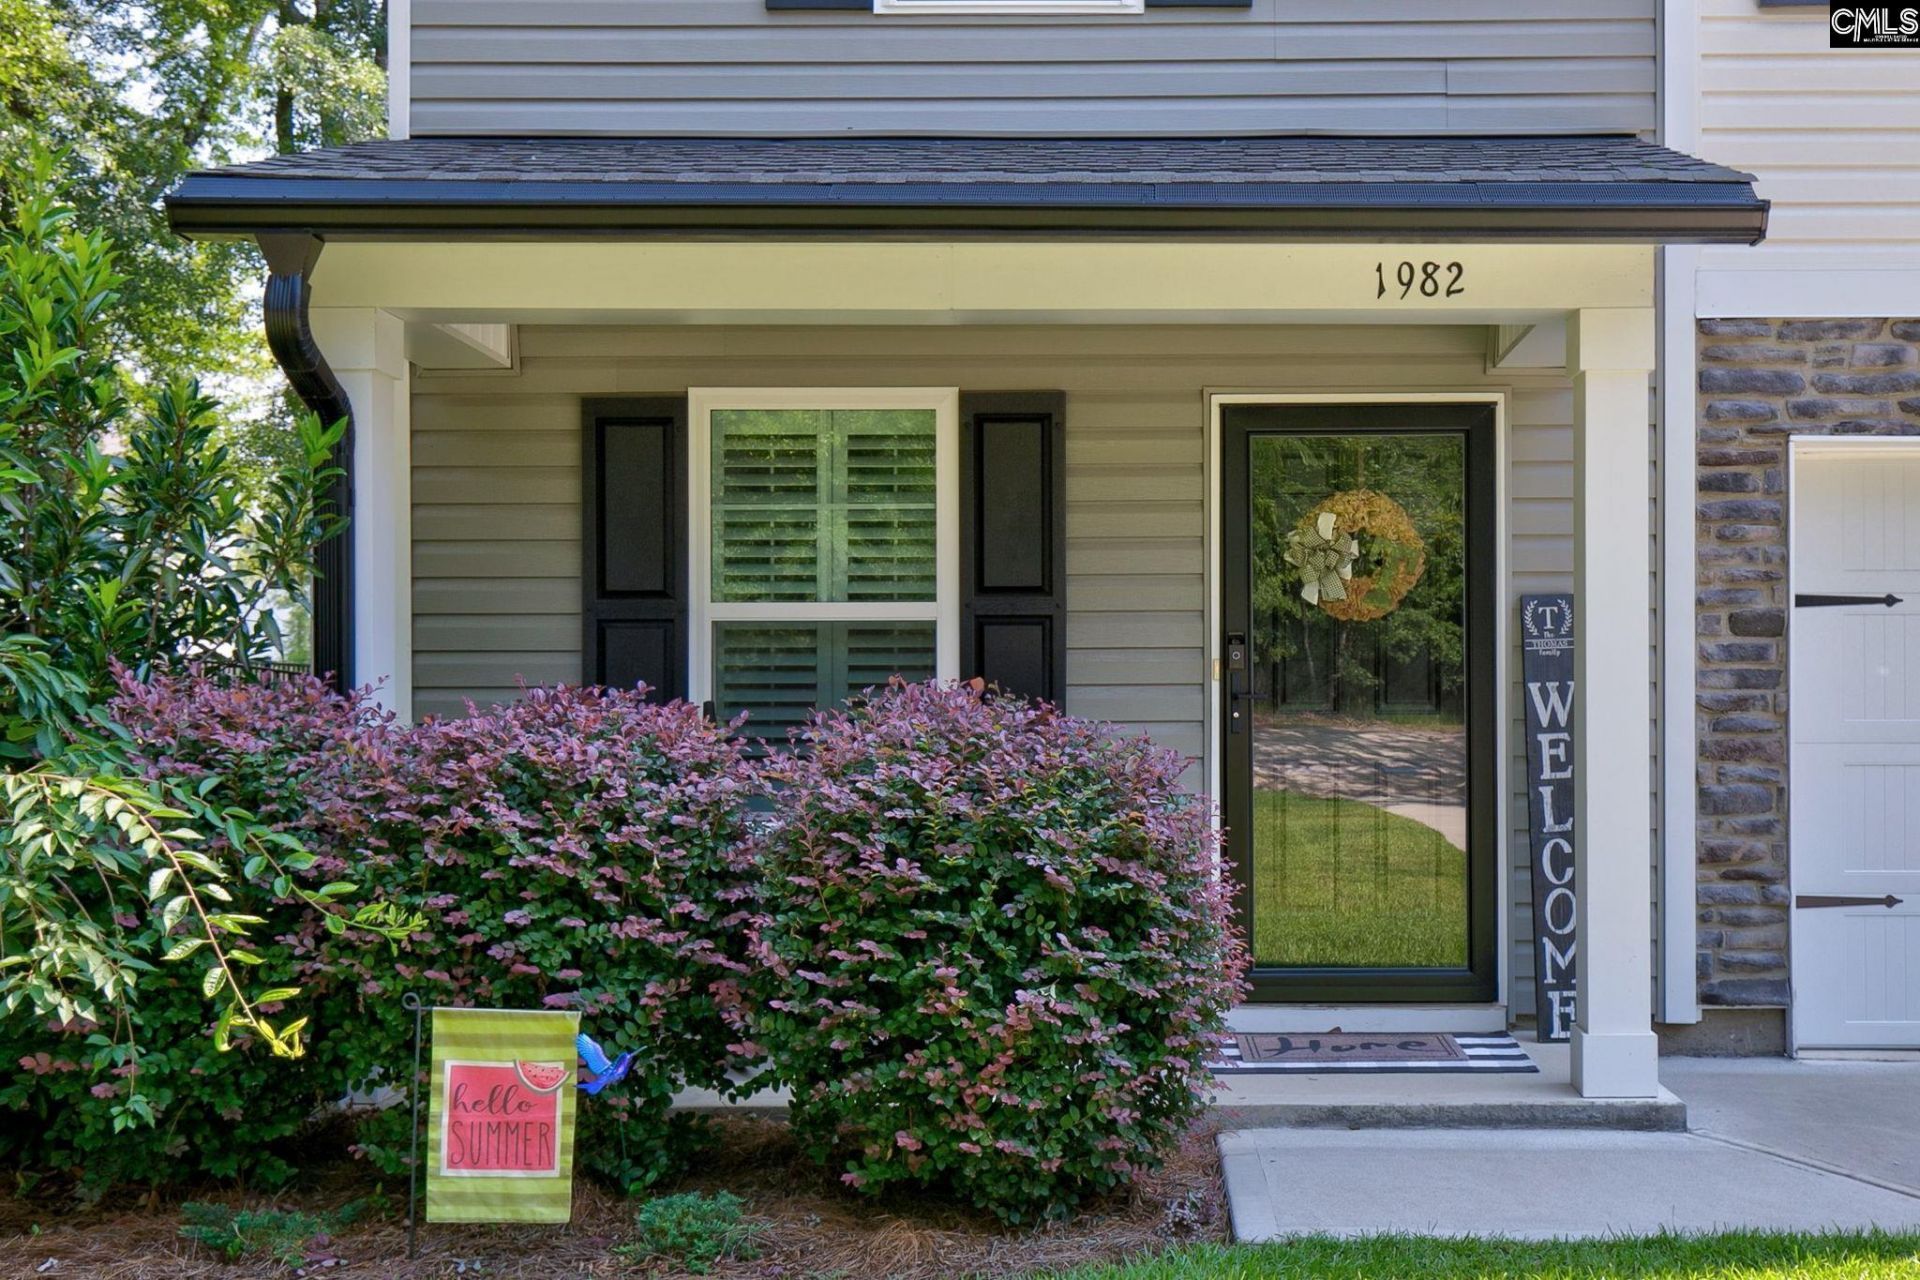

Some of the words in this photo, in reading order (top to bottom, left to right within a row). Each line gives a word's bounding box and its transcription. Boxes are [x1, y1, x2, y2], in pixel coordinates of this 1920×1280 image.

[1376, 261, 1465, 300] 1982
[1538, 606, 1558, 629] T
[1532, 639, 1568, 649] THOMAS
[453, 1082, 538, 1115] hello
[451, 1121, 551, 1167] SUMMER
